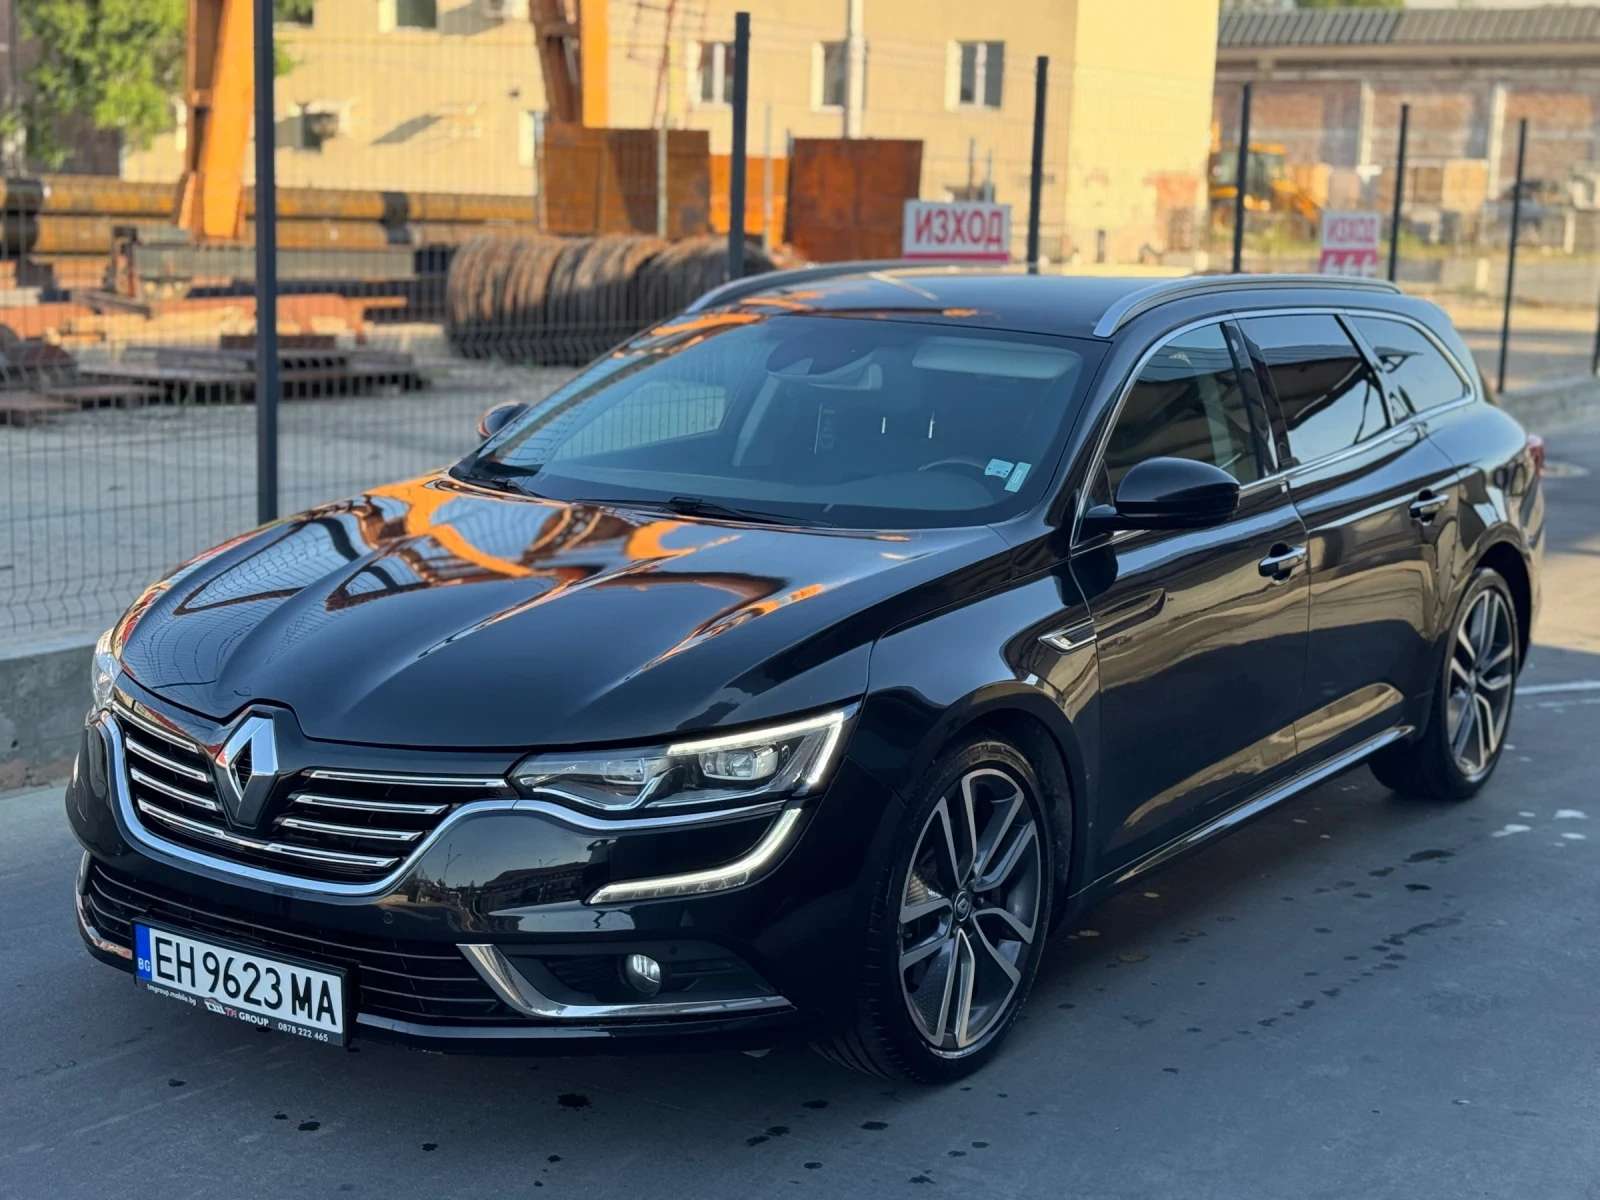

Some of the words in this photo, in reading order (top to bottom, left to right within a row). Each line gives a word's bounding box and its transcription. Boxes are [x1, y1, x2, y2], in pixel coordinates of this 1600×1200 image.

[915, 208, 1004, 252] ИЗХОД
[138, 957, 151, 973] BG
[155, 936, 196, 988] EH
[202, 951, 283, 1010] 9623
[291, 972, 337, 1026] MA
[147, 983, 197, 1007] tmgroup.mobile.bg
[239, 1011, 269, 1027] GROUP
[278, 1022, 297, 1034] 0878
[298, 1027, 313, 1038] 222
[314, 1032, 329, 1042] 465
